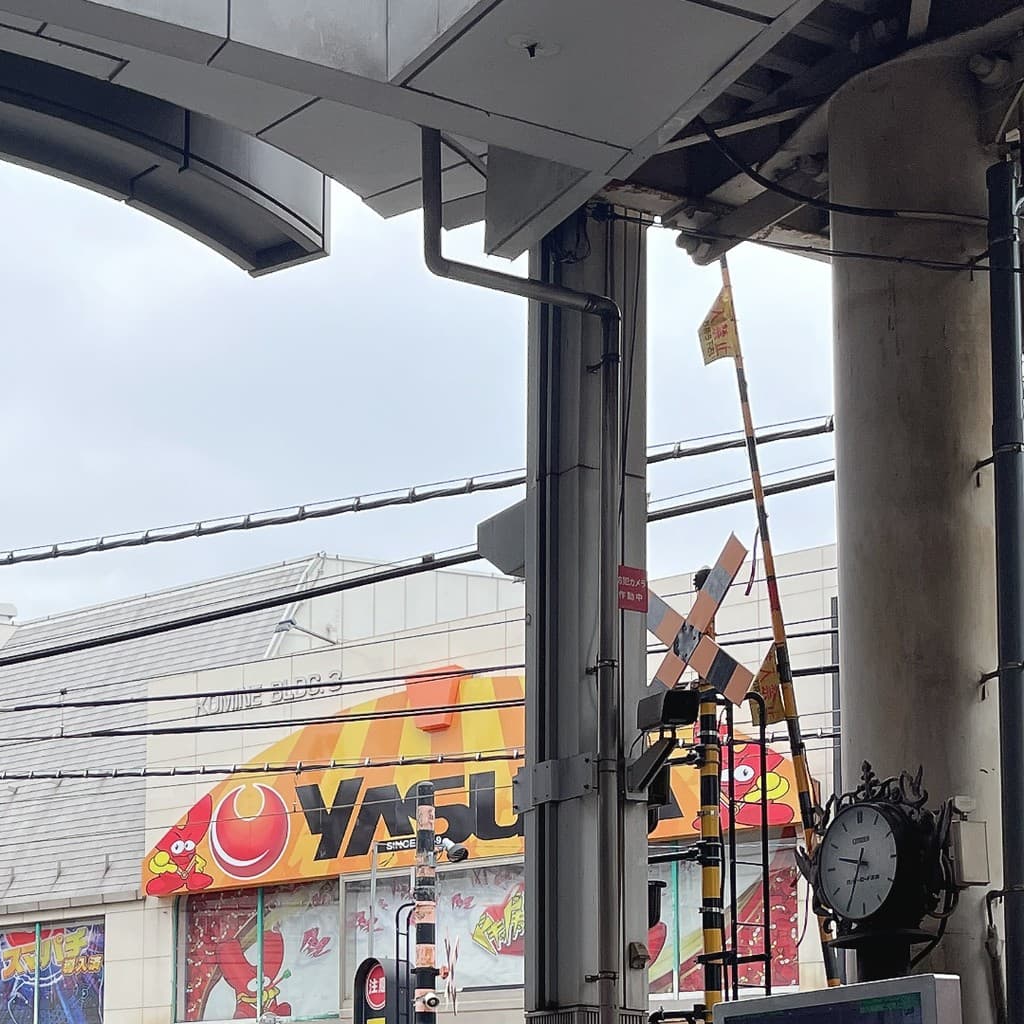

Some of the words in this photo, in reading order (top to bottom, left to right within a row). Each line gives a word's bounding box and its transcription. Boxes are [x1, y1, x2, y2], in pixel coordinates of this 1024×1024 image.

[386, 837, 416, 851] SINCE
[2, 927, 88, 981] スマパチ
